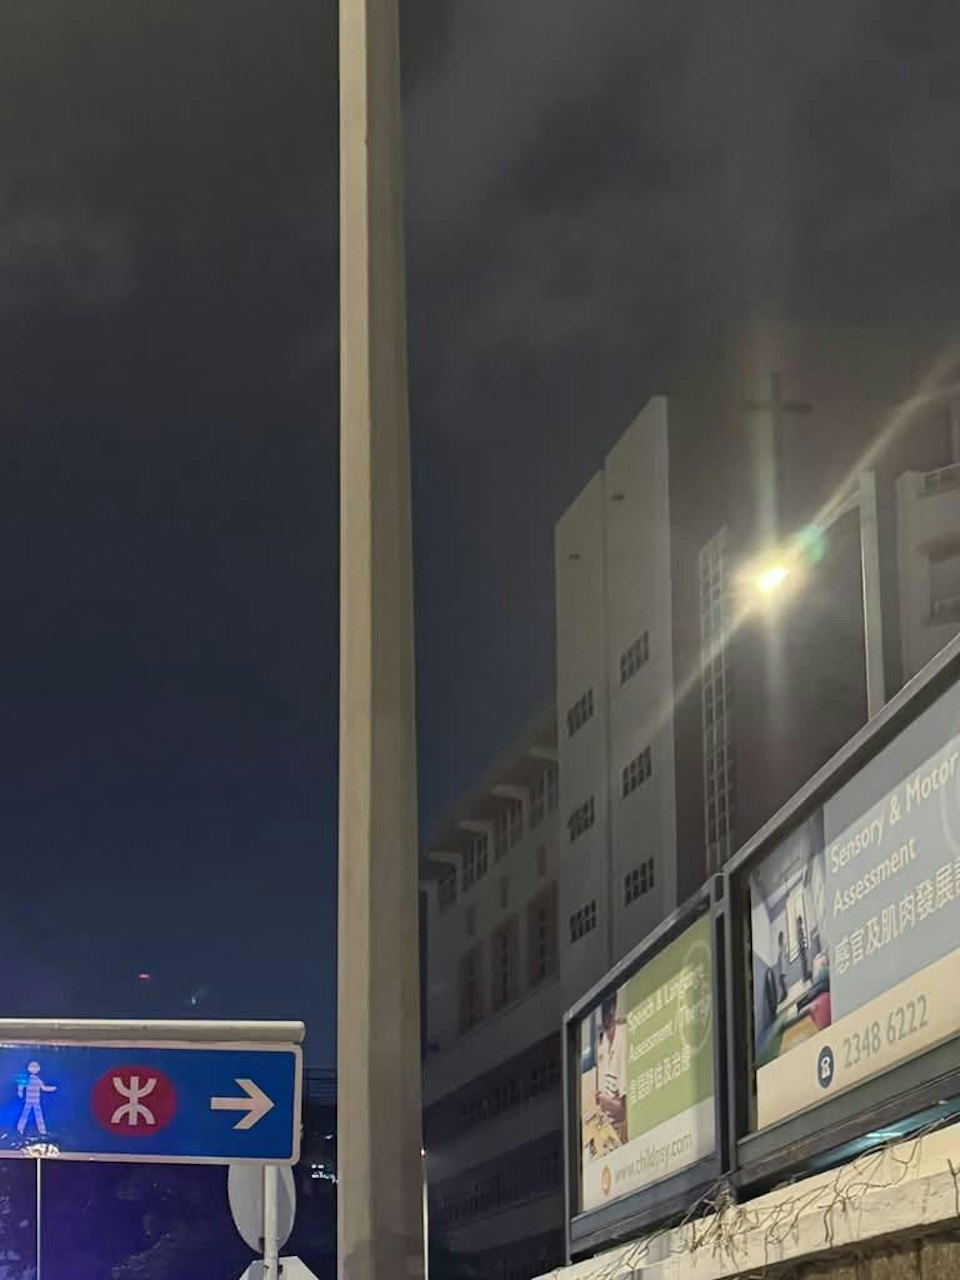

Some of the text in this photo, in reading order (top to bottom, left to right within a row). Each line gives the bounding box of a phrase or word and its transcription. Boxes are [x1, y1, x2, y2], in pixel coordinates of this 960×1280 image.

[830, 752, 959, 873] Sensory & Motor
[833, 836, 918, 917] Assessment
[843, 994, 928, 1069] 2348 6222
